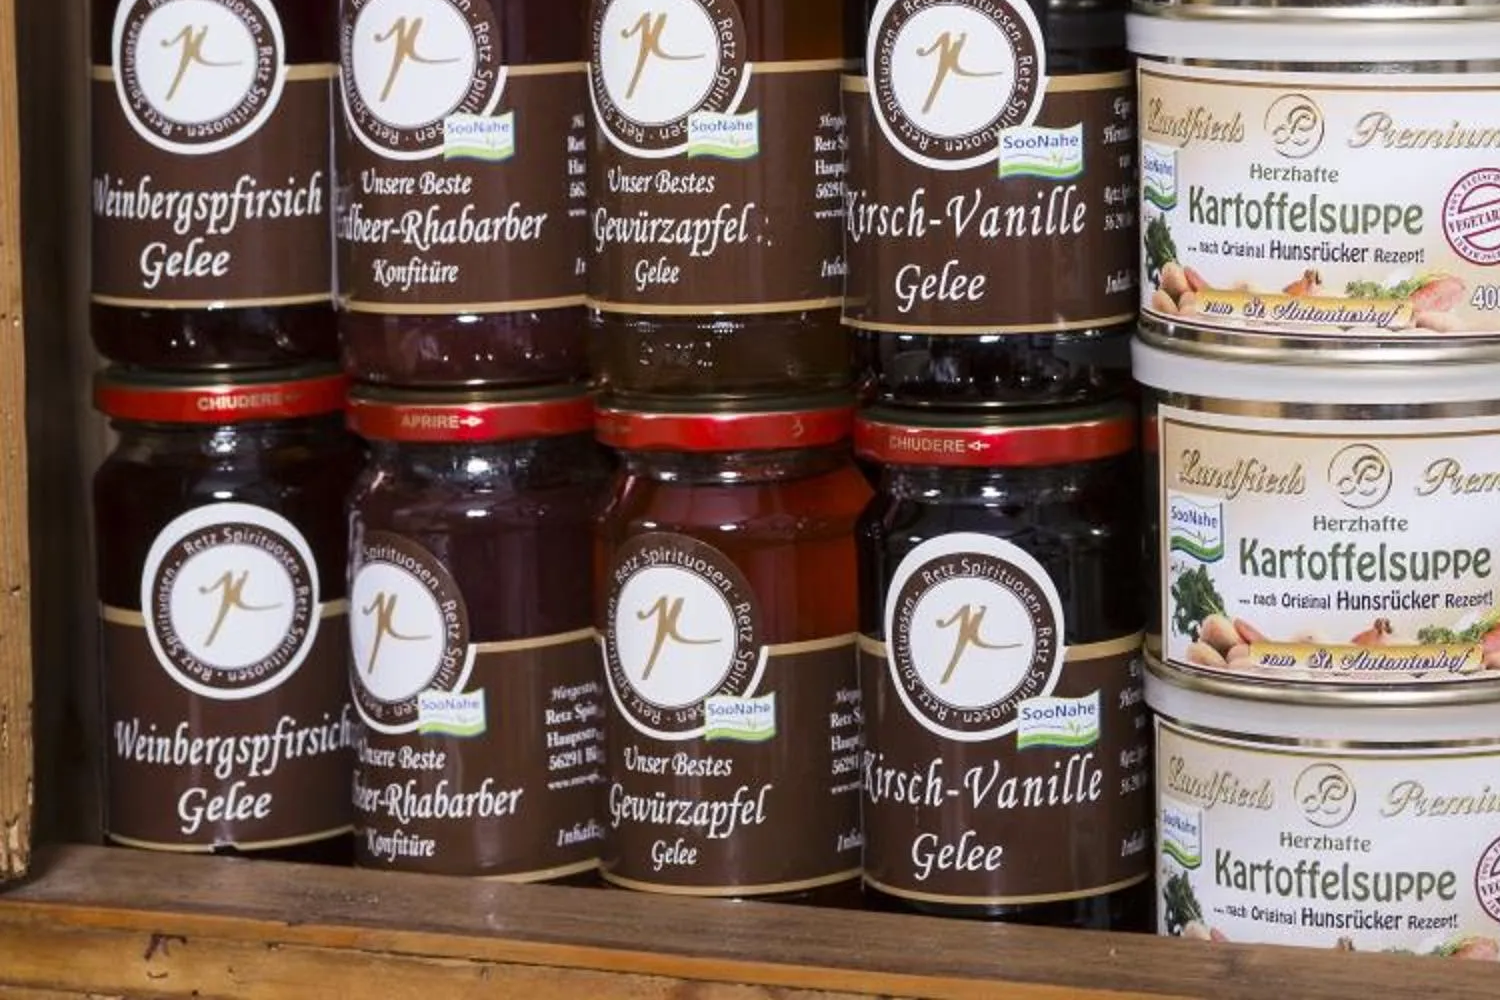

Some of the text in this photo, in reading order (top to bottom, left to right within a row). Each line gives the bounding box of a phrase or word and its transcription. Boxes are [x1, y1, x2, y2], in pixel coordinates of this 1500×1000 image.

[447, 120, 510, 136] SooNahe
[690, 118, 754, 133] SooNahe
[1003, 132, 1079, 150] SooNahe
[361, 168, 473, 195] Unsere Beste
[608, 168, 715, 194] Unser Bestes
[1249, 162, 1340, 183] Herzhafte
[94, 170, 323, 237] Weinbergspfirsich
[846, 185, 1087, 242] Kirsch-Vanille
[1189, 185, 1425, 235] Kartoffelsuppe
[593, 203, 755, 257] Gewürzapfel
[140, 239, 230, 289] Gelee
[1269, 241, 1426, 265] Hunsrücker Rezept!
[373, 257, 459, 294] Konfitüre
[635, 257, 680, 291] Gelee
[895, 262, 986, 312] Gelee
[197, 392, 283, 412] CHIUDERE
[401, 414, 459, 429] APRIRE
[889, 436, 966, 453] CHIUDERE
[1313, 514, 1409, 533] Herzhafte
[184, 527, 301, 581] Retz Spirituosen
[640, 547, 732, 592] Spirituosen
[1239, 537, 1492, 583] Kartoffelsuppe
[922, 559, 1042, 615] Retz Spirituosen
[1281, 590, 1493, 611] Original Hunsrücker Rezept!
[707, 701, 771, 716] SooNahe
[1021, 701, 1096, 720] SooNahe
[113, 708, 352, 779] Weinbergspfirsich
[398, 745, 446, 771] Beste
[624, 747, 732, 776] Unser Bestes
[862, 752, 1103, 810] Kirsch-Vanille
[177, 785, 272, 832] Gelee
[609, 783, 773, 839] Gewürzapfel
[368, 828, 436, 862] Konfitüre
[652, 839, 697, 871] Gelee
[912, 831, 1003, 881] Gelee
[1280, 831, 1372, 853] Herzhafte
[1214, 847, 1457, 903] Kartoffelsuppe
[1301, 906, 1458, 930] Hunsrücker Rezept!
